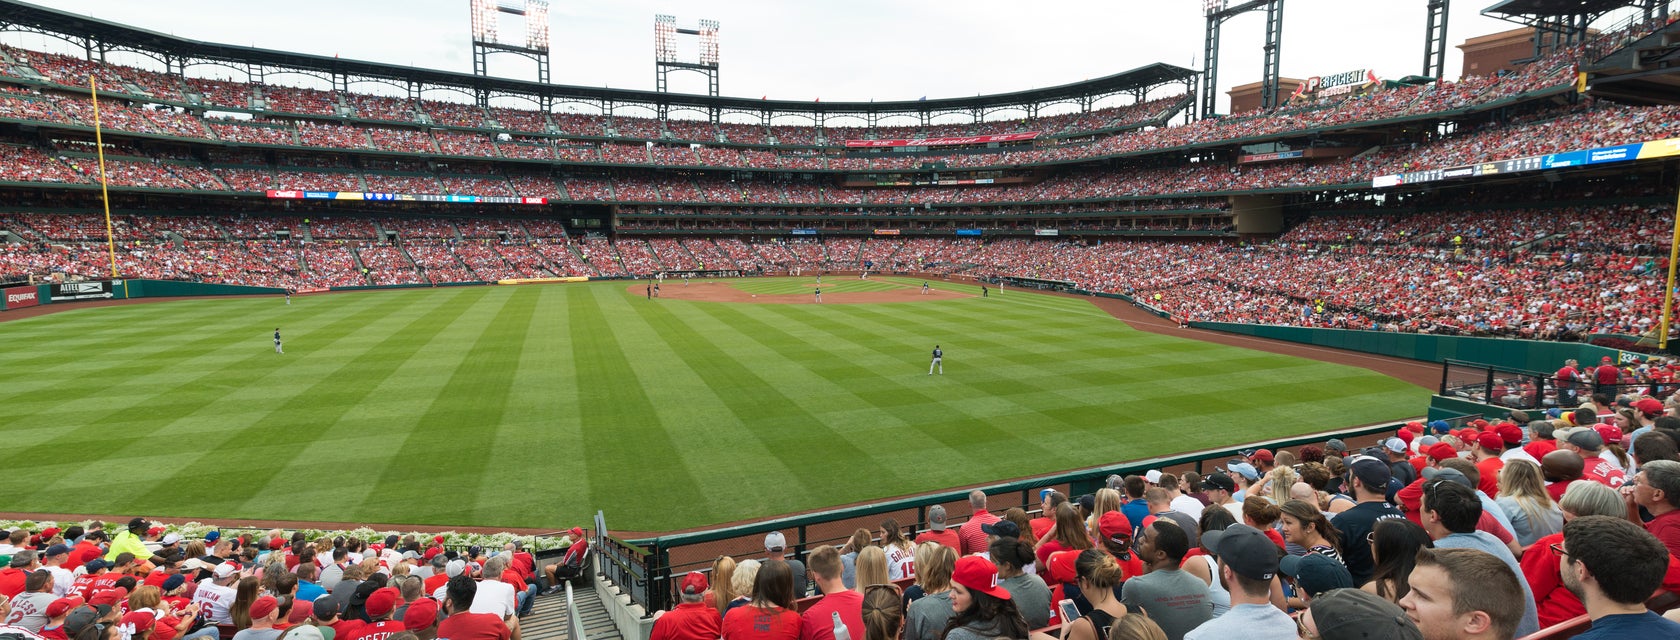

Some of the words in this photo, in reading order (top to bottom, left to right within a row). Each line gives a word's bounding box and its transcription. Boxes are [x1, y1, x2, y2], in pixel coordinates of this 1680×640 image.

[1307, 69, 1365, 92] PERFICIENT
[1318, 86, 1352, 98] PERCH
[8, 292, 36, 303] EQUIFAX
[199, 590, 220, 602] DUNCAN
[8, 610, 25, 625] 2
